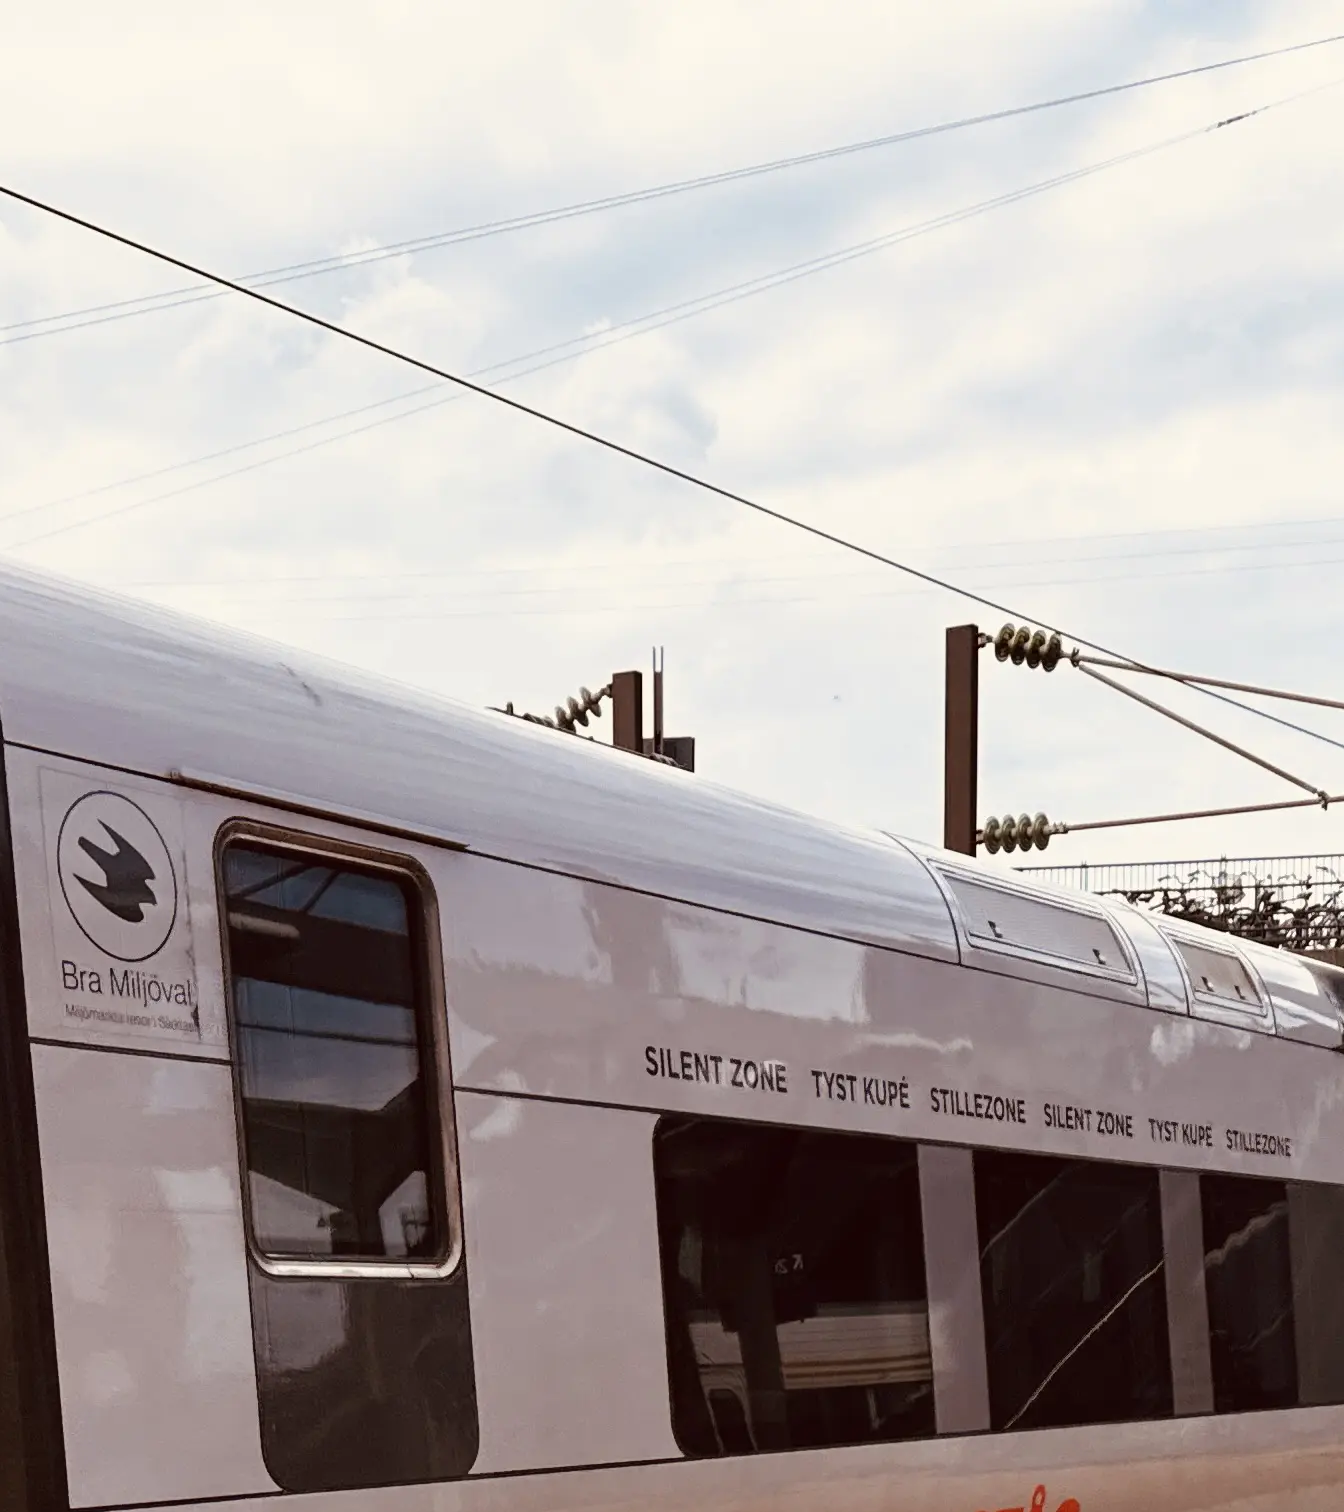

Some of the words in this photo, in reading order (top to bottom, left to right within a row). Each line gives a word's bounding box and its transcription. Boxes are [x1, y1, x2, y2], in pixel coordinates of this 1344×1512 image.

[61, 960, 103, 994] Bra
[109, 967, 194, 1008] Miljöval
[645, 1045, 723, 1084] SILENT
[729, 1058, 788, 1093] ZONE
[811, 1070, 857, 1102] TYST
[863, 1076, 911, 1108] KUPÉ
[930, 1087, 1026, 1124] STILLEZONE
[1044, 1103, 1092, 1132] SILENT
[1096, 1110, 1133, 1137] ZONE
[1148, 1118, 1179, 1142] TYST
[1226, 1128, 1292, 1157] STILLEZONE
